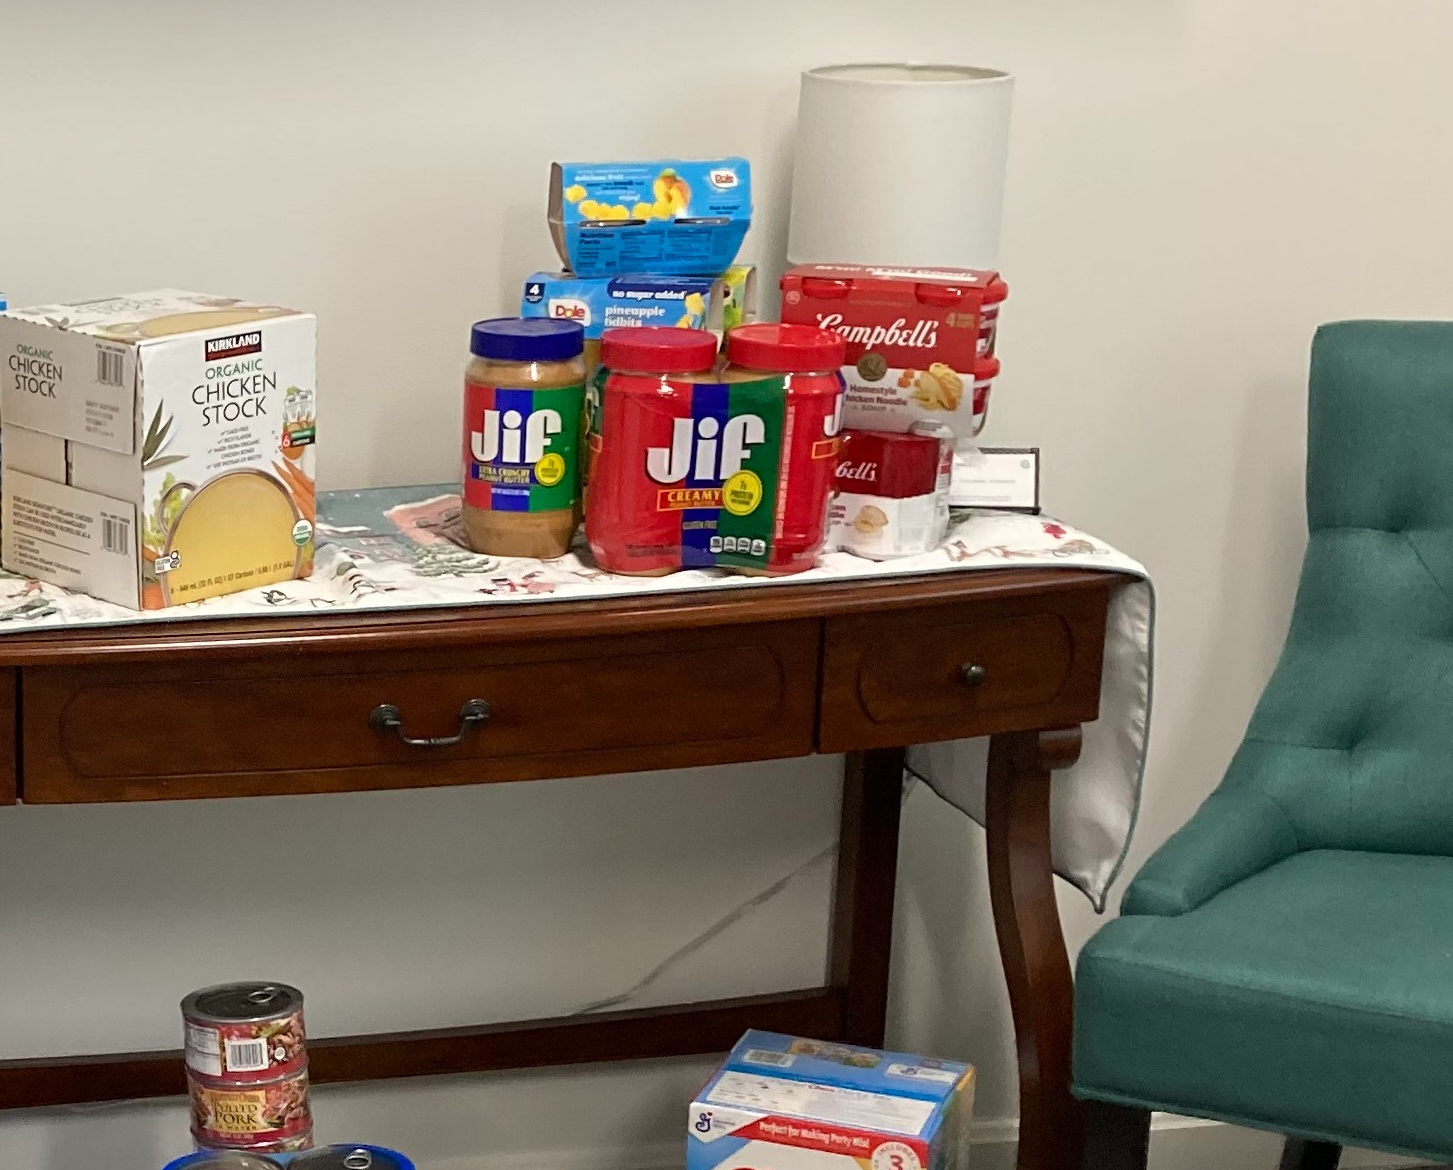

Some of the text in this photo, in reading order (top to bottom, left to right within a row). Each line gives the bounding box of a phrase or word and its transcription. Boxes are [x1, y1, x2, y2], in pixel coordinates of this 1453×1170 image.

[715, 174, 734, 184] Dole
[530, 284, 540, 294] 4
[613, 290, 685, 302] no sugar added
[555, 304, 585, 318] Dole
[605, 305, 666, 318] pineapple
[604, 317, 642, 328] tidbits
[816, 313, 938, 350] Campbell's
[207, 333, 260, 353] KIRKLAND
[16, 344, 53, 361] ORGANIC
[9, 354, 63, 382] CHICKEN
[205, 358, 263, 380] ORGANIC
[15, 374, 56, 399] STOCK
[191, 372, 277, 406] CHICKEN
[202, 396, 268, 427] STOCK
[282, 435, 292, 447] 6
[471, 409, 562, 464] Jif
[646, 413, 765, 484] Jif
[836, 461, 877, 482] bell's
[667, 490, 720, 502] CREAMY
[215, 1112, 258, 1125] PORK
[759, 1121, 787, 1136] Perfect
